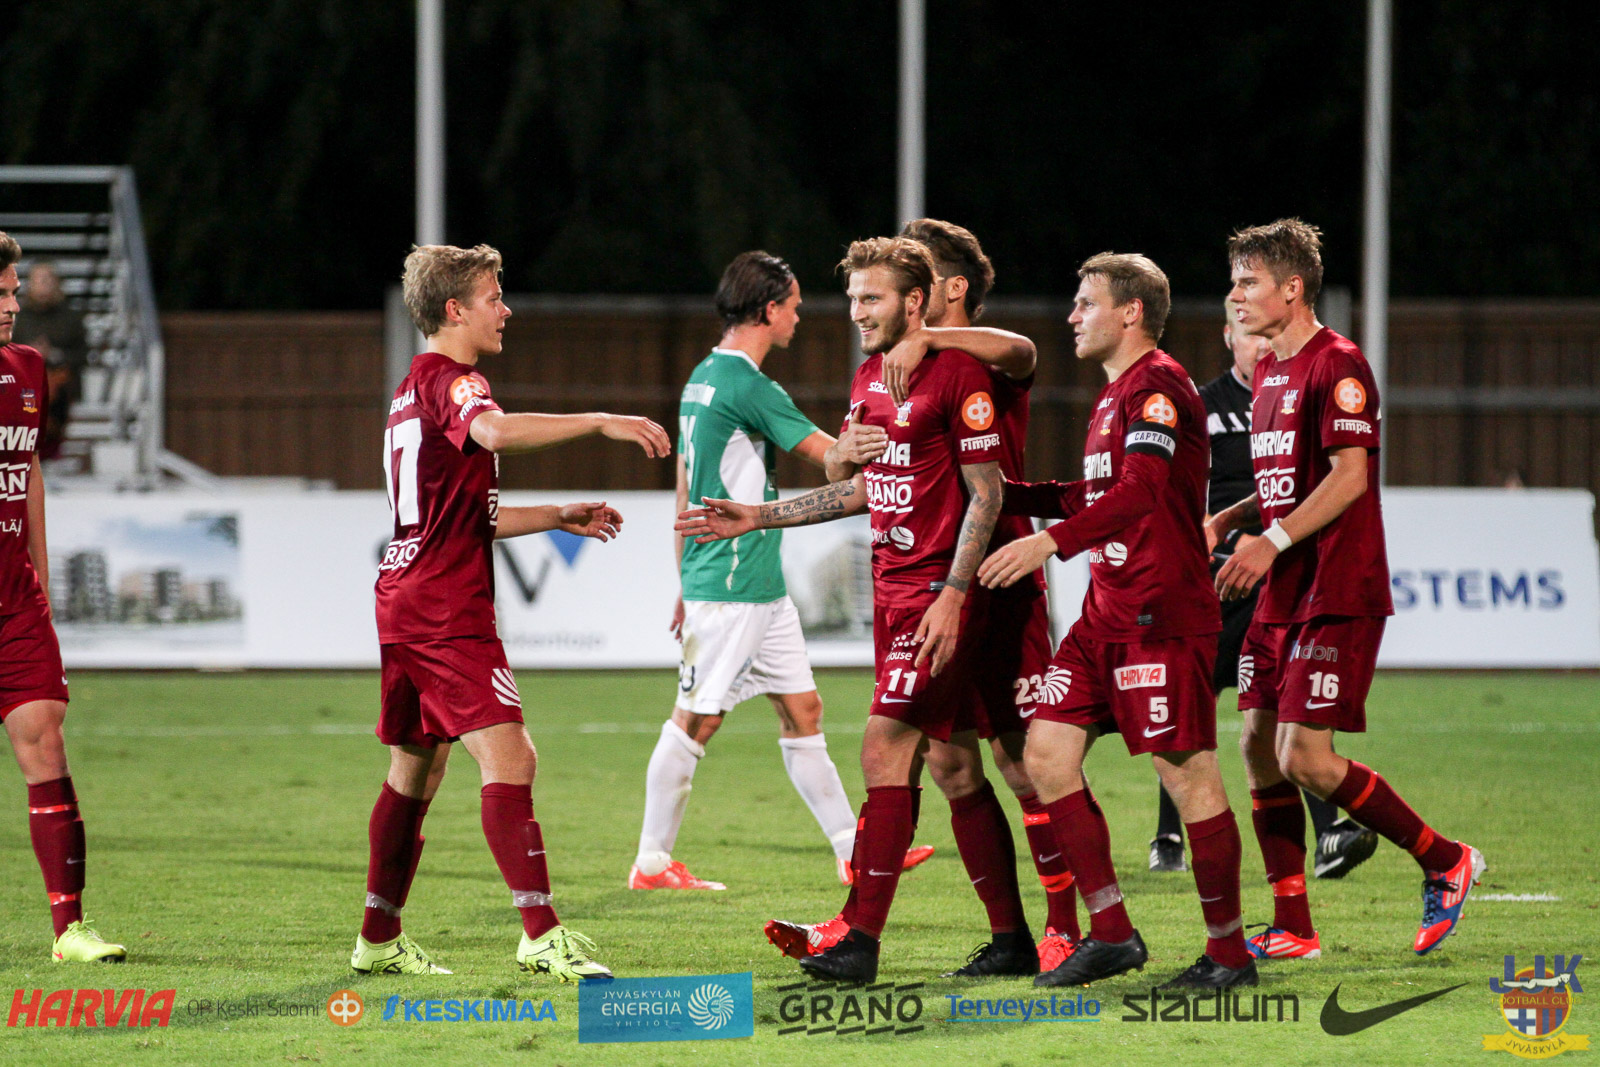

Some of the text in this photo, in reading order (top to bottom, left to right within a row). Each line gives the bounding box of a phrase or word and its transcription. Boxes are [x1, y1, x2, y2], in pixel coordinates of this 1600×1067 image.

[0, 427, 39, 451] RVIA
[1134, 432, 1172, 447] CAPTAIN
[383, 418, 421, 526] 17
[1392, 568, 1567, 613] STEMS
[1290, 638, 1338, 662] idon
[888, 668, 918, 696] 11
[1014, 674, 1043, 705] 23
[1309, 671, 1339, 699] 16
[1150, 697, 1168, 723] 5
